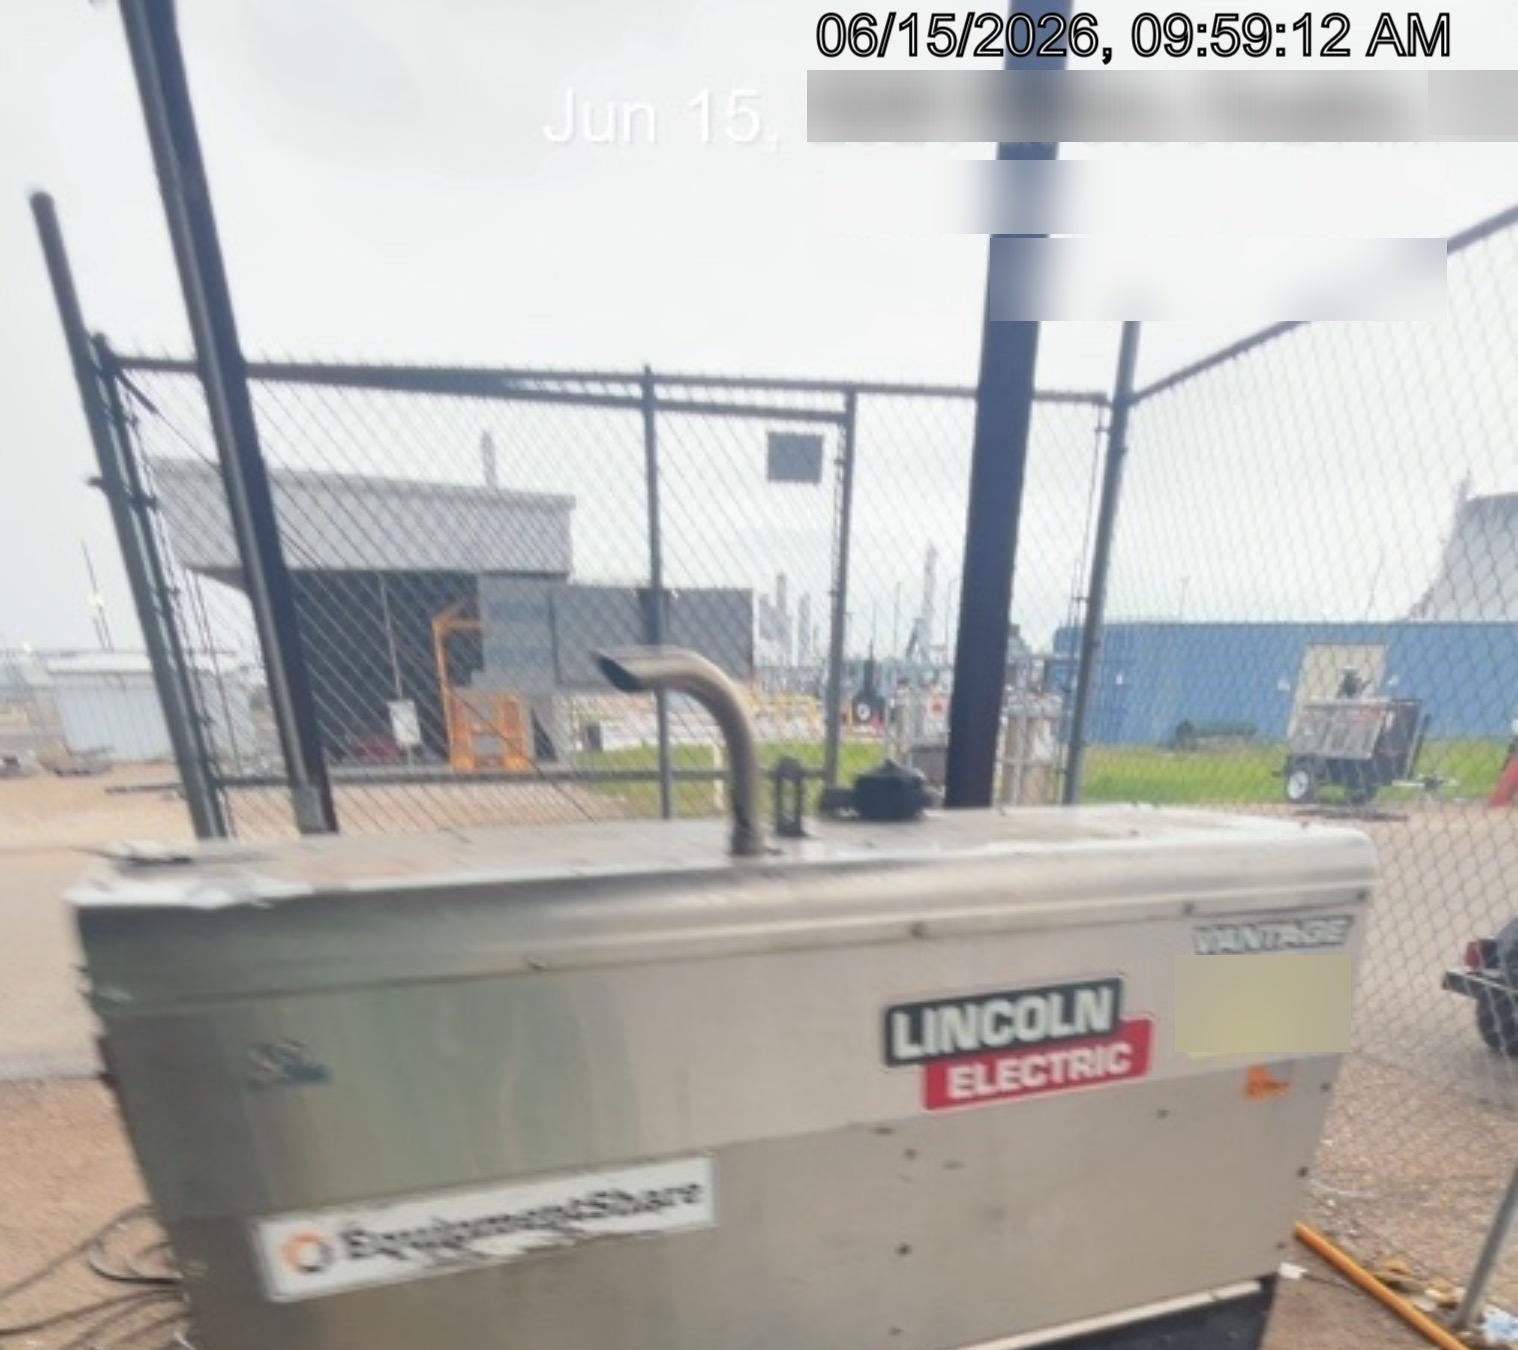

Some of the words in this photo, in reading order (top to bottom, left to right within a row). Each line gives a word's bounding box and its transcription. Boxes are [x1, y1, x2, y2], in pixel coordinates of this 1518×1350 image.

[1193, 915, 1354, 956] VANTAGE
[892, 984, 1116, 1060] LINCOLN
[947, 1042, 1133, 1100] ELECTRIC
[341, 1177, 703, 1262] EquipmentShare
